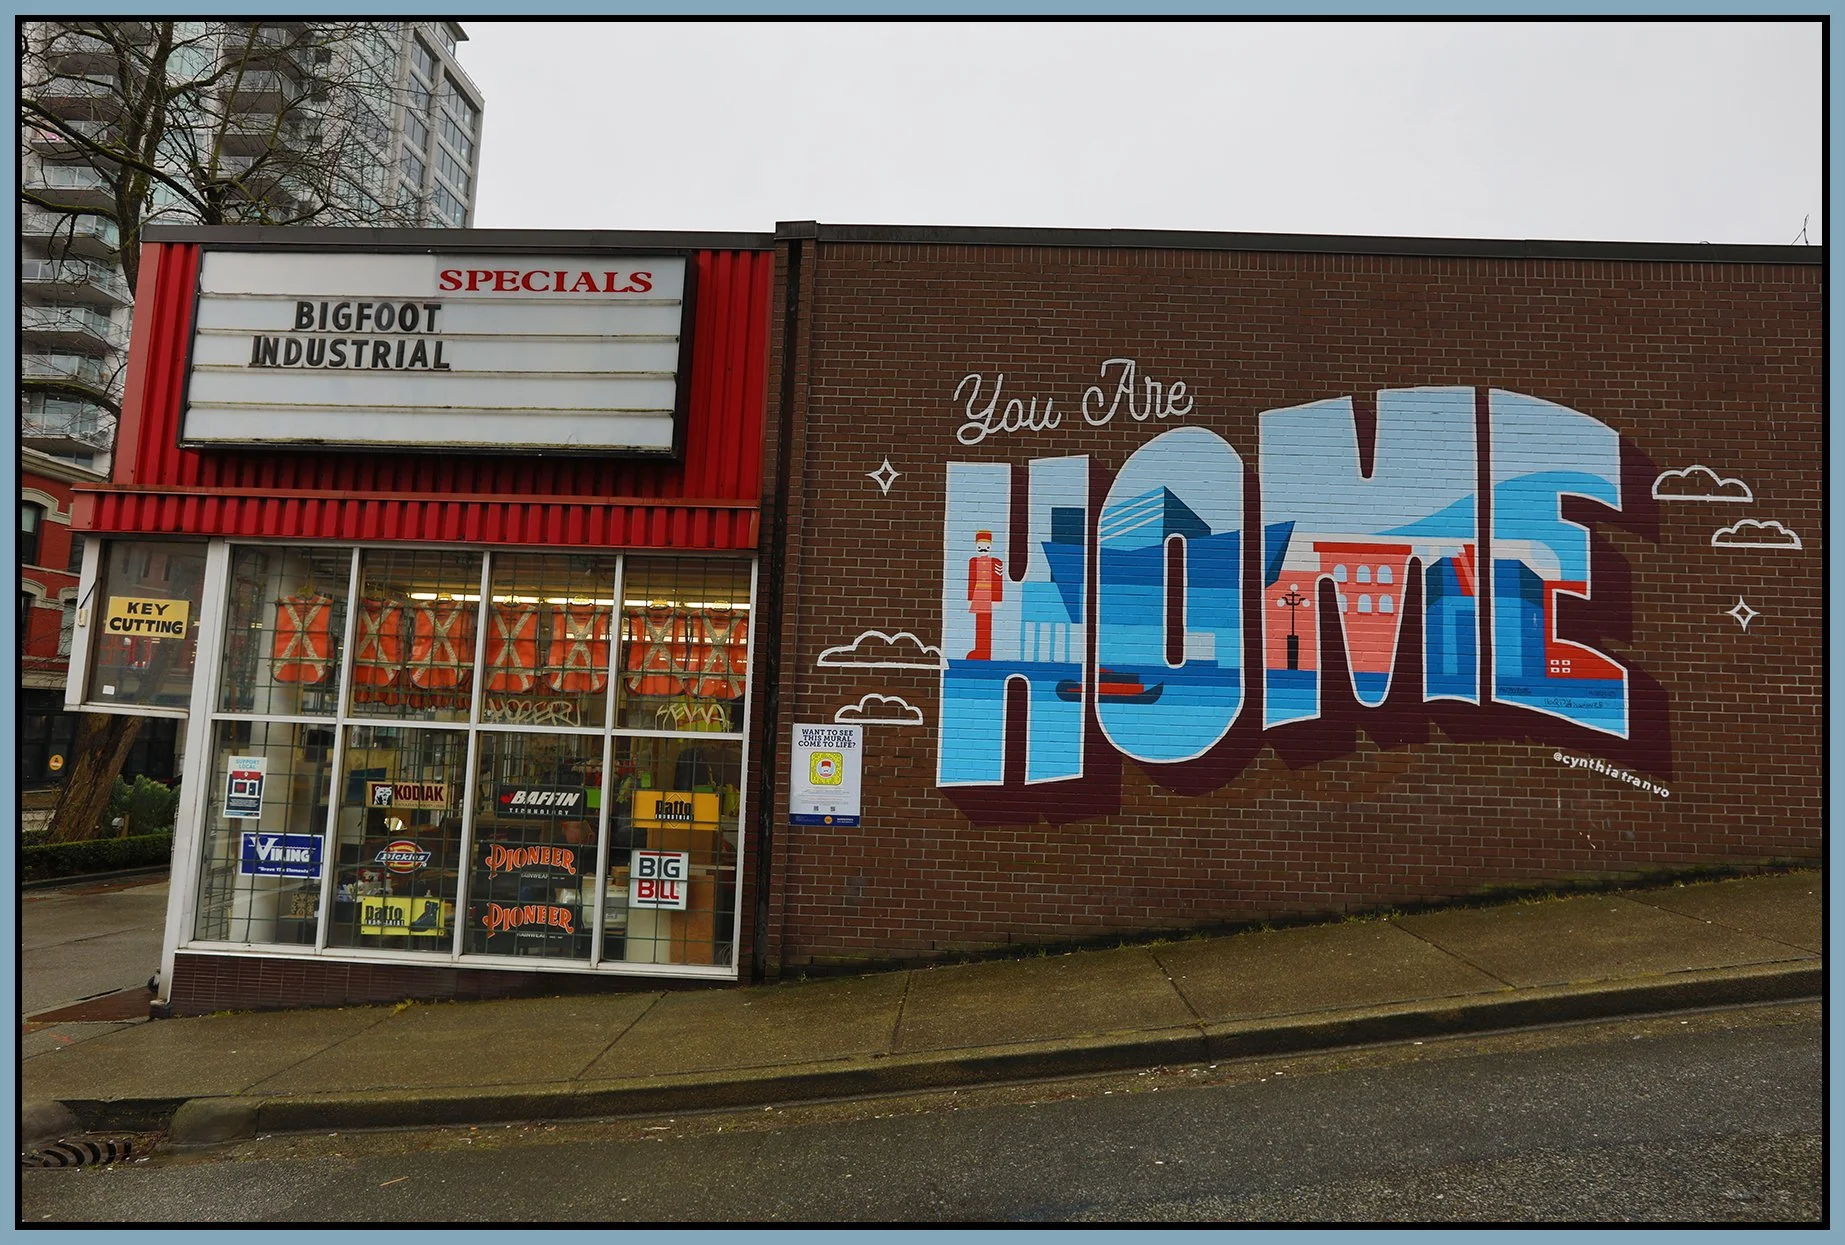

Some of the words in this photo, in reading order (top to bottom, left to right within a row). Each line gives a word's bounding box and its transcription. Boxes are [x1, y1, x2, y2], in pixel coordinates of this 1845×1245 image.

[439, 269, 653, 293] SPECIALS
[295, 301, 441, 332] BIGFOOT
[250, 335, 450, 370] INDUSTRIAL
[953, 373, 1062, 445] You
[1082, 358, 1194, 426] Are
[936, 385, 1630, 788] HOME
[127, 601, 170, 616] KEY
[109, 617, 184, 635] CUTTING
[801, 728, 826, 736] WANT
[394, 785, 444, 801] KODIAK
[510, 790, 580, 807] BAFFIN
[249, 836, 310, 863] VIKING
[380, 852, 426, 861] Dickies
[485, 843, 576, 880] PIONEER
[638, 857, 680, 878] BIG
[637, 879, 680, 900] BILL
[482, 902, 574, 939] PIONEER
